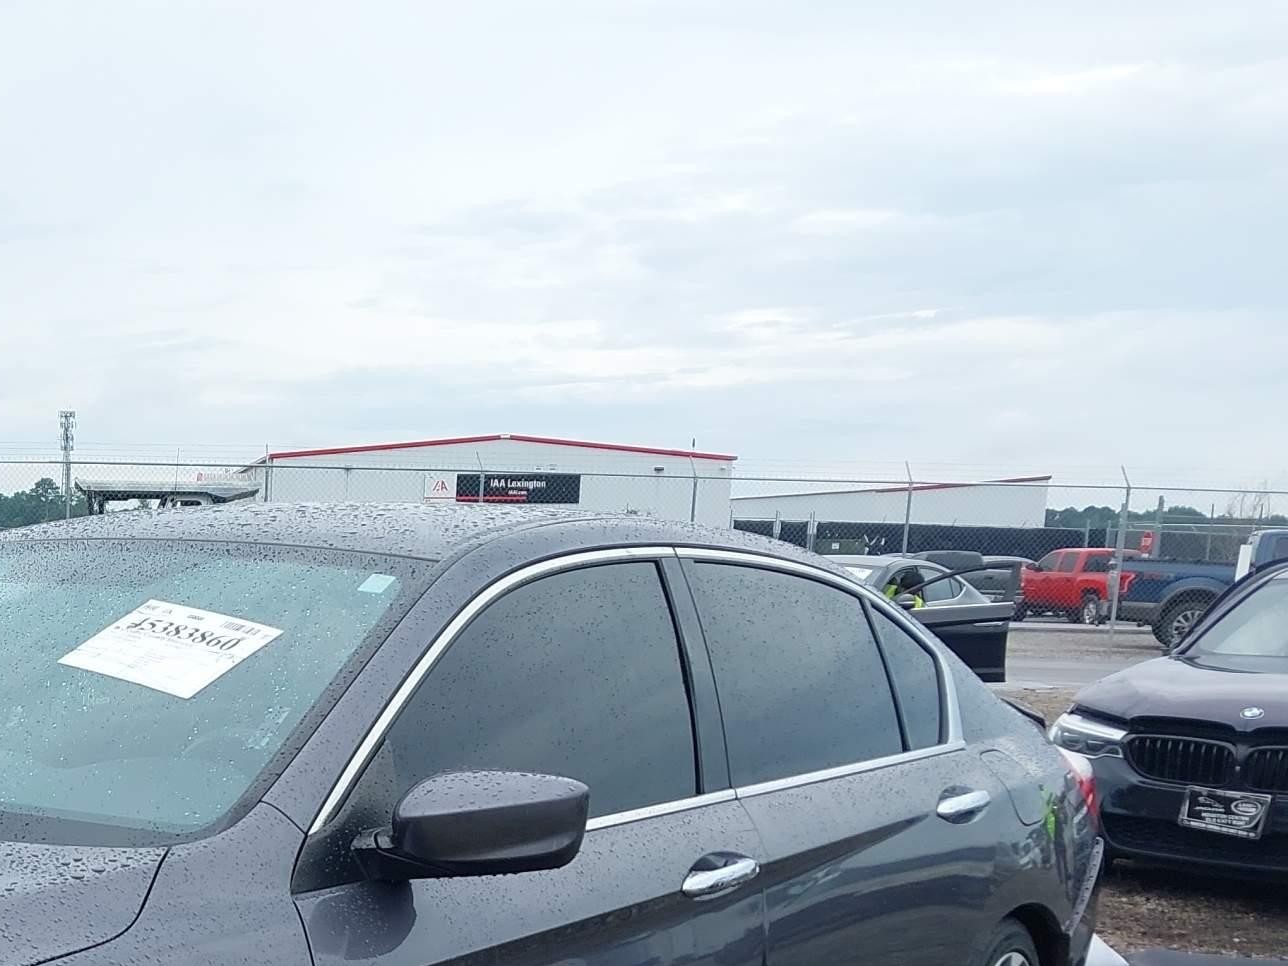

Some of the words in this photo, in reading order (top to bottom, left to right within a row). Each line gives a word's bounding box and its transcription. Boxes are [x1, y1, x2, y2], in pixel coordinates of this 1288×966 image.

[490, 478, 506, 488] IAA
[507, 478, 547, 489] Lexington
[126, 617, 243, 651] 45383860
